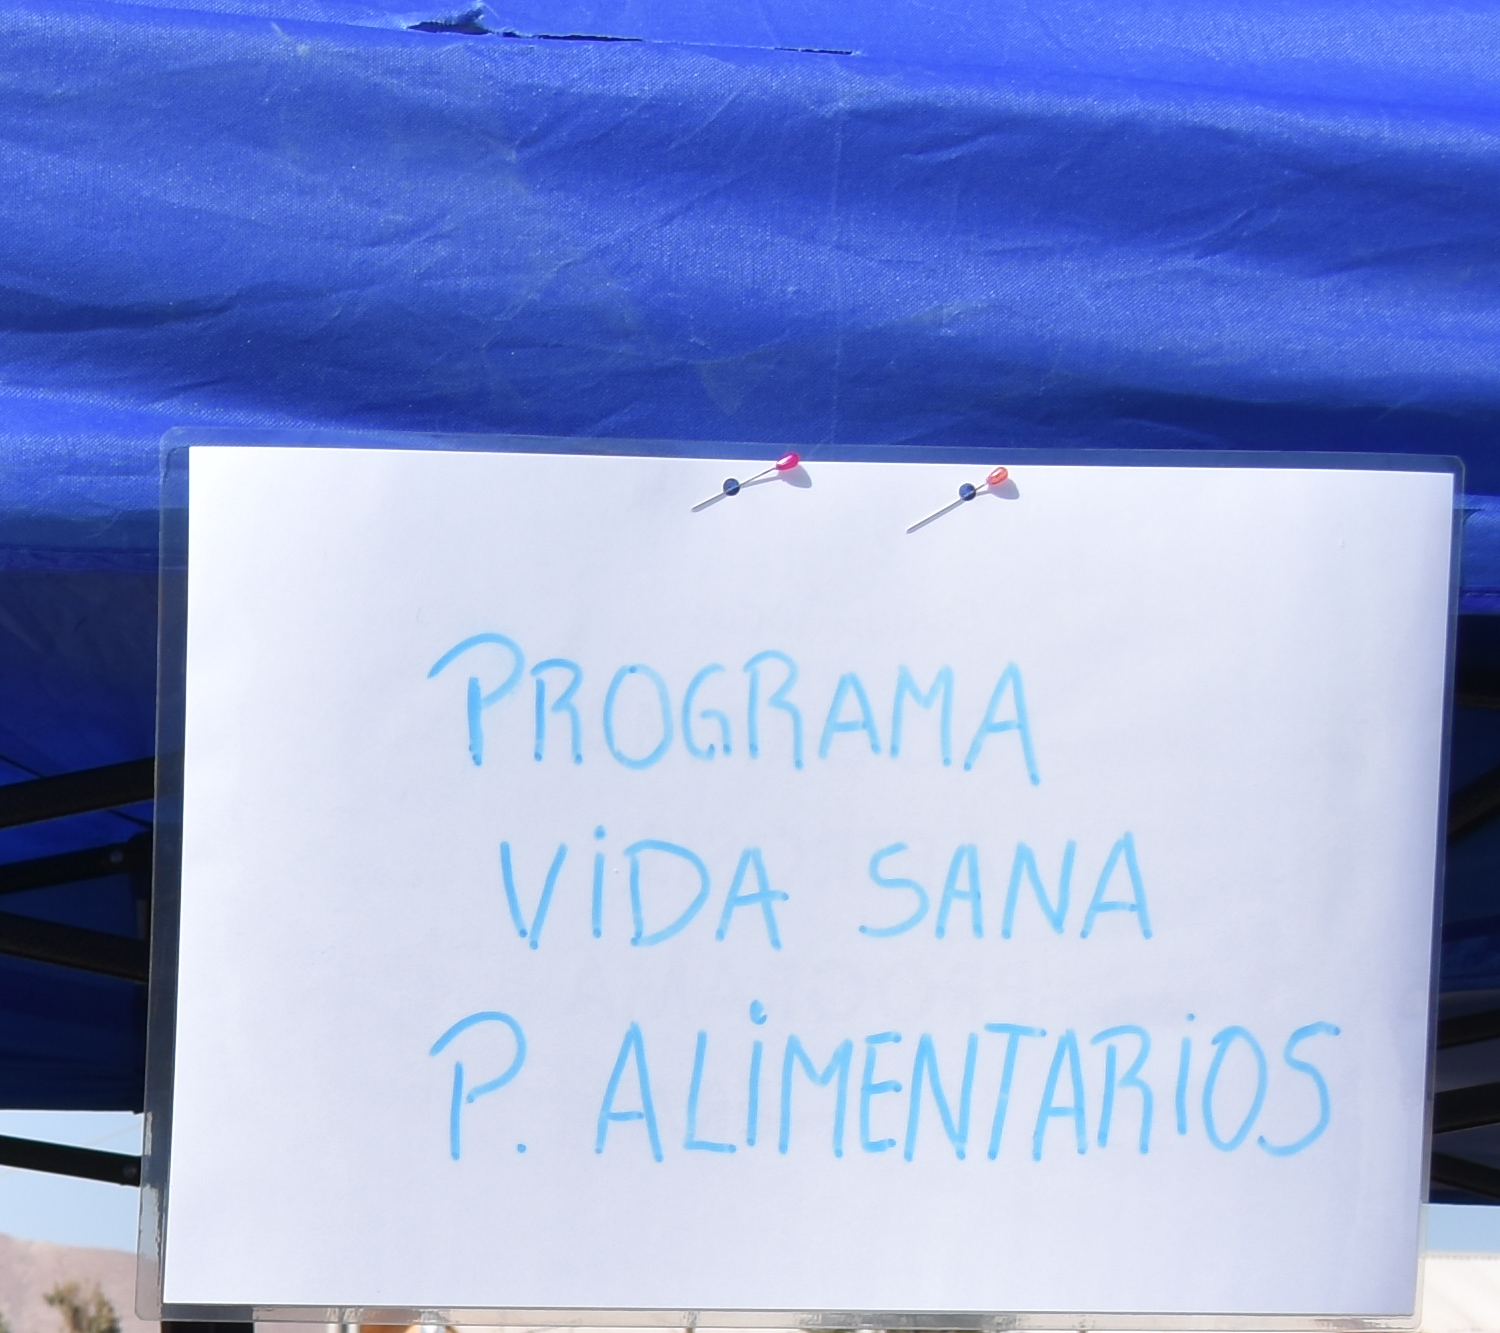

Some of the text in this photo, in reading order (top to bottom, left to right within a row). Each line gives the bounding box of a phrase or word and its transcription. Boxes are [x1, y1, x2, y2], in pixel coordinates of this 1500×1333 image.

[428, 632, 1041, 786] PROGRAMA
[858, 830, 1154, 942] SANA
[430, 1010, 528, 1161] P.
